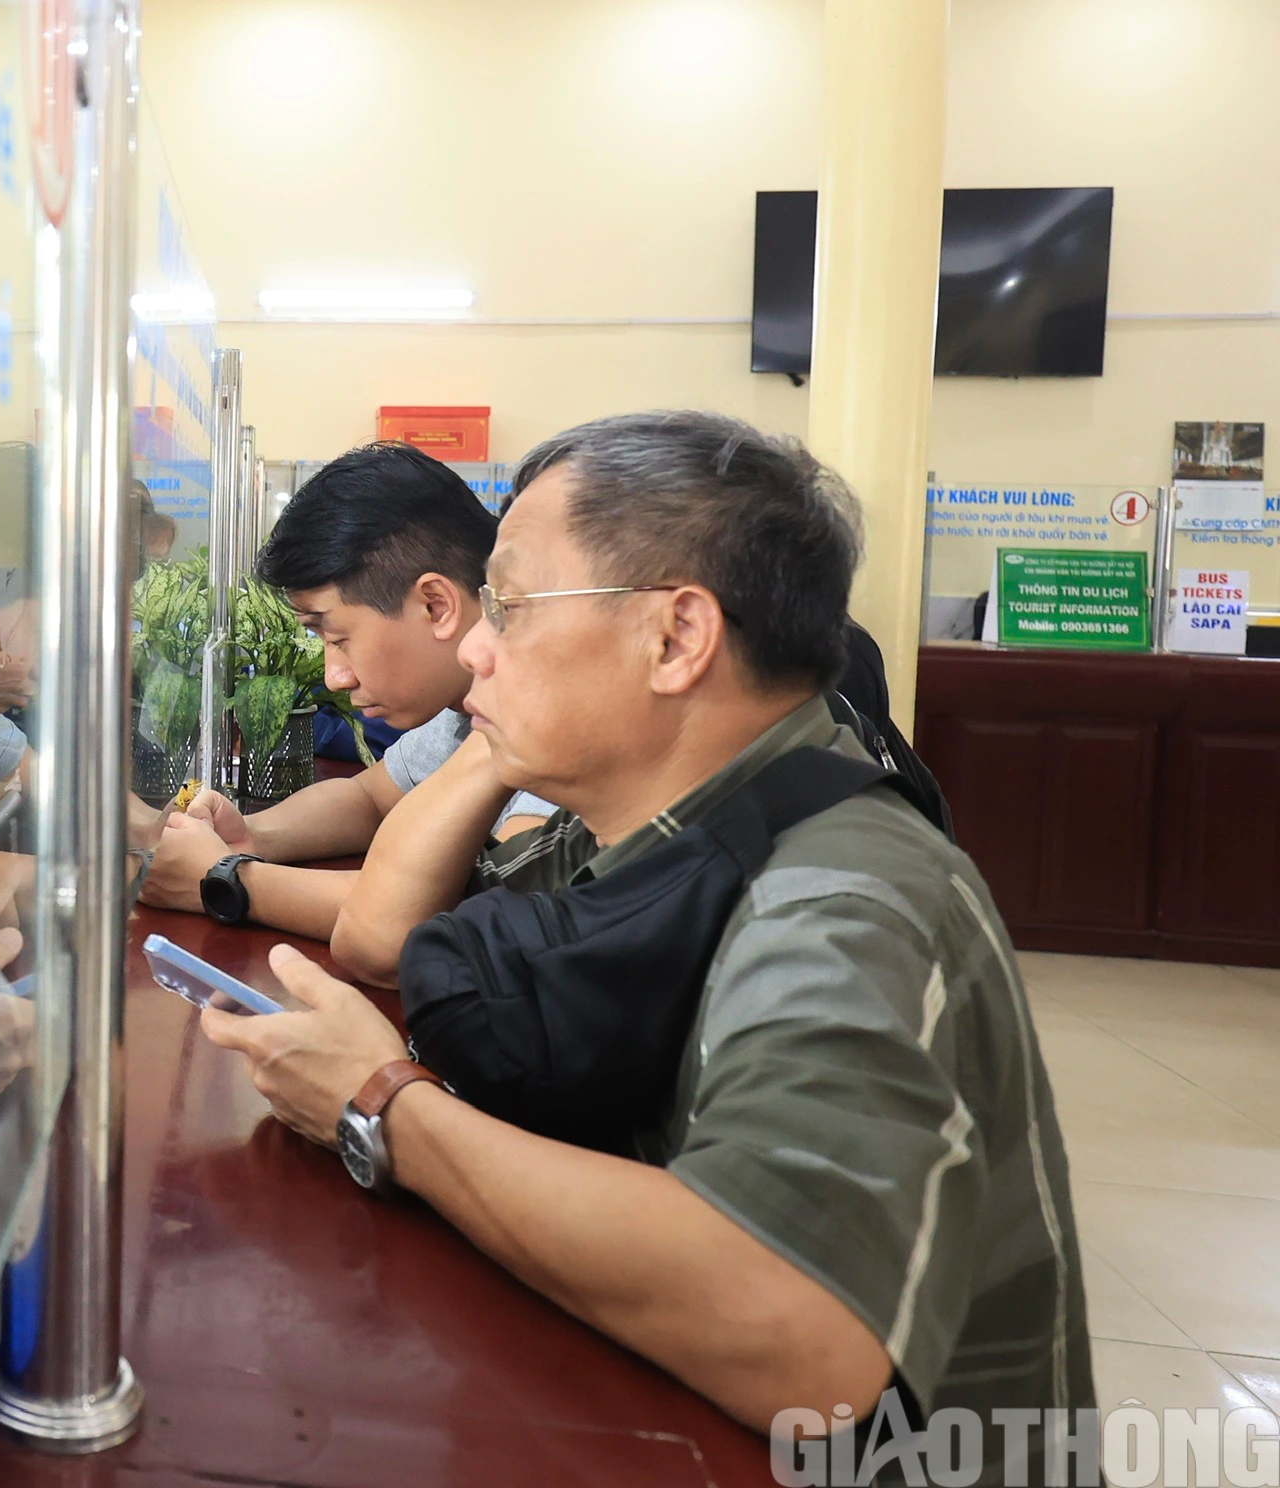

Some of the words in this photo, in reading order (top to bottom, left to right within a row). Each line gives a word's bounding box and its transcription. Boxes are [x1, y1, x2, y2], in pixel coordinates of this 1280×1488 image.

[949, 487, 998, 505] KHÁCH
[1003, 489, 1027, 505] VUI
[1032, 489, 1075, 507] LÒNG:
[1117, 497, 1137, 520] 4
[1191, 517, 1222, 530] Cung
[1225, 517, 1248, 531] cấp
[1198, 573, 1228, 584] BUS
[1018, 582, 1058, 596] THÔNG
[1061, 585, 1080, 597] TIN
[1083, 586, 1100, 597] DU
[1103, 587, 1129, 600] LỊCH
[1183, 587, 1242, 599] TICKETS
[1008, 601, 1057, 614] TOURIST
[1060, 603, 1139, 617] INFORMATION
[1216, 604, 1241, 615] CAI
[1018, 620, 1058, 632] Mobile:
[1191, 618, 1231, 630] SAPA
